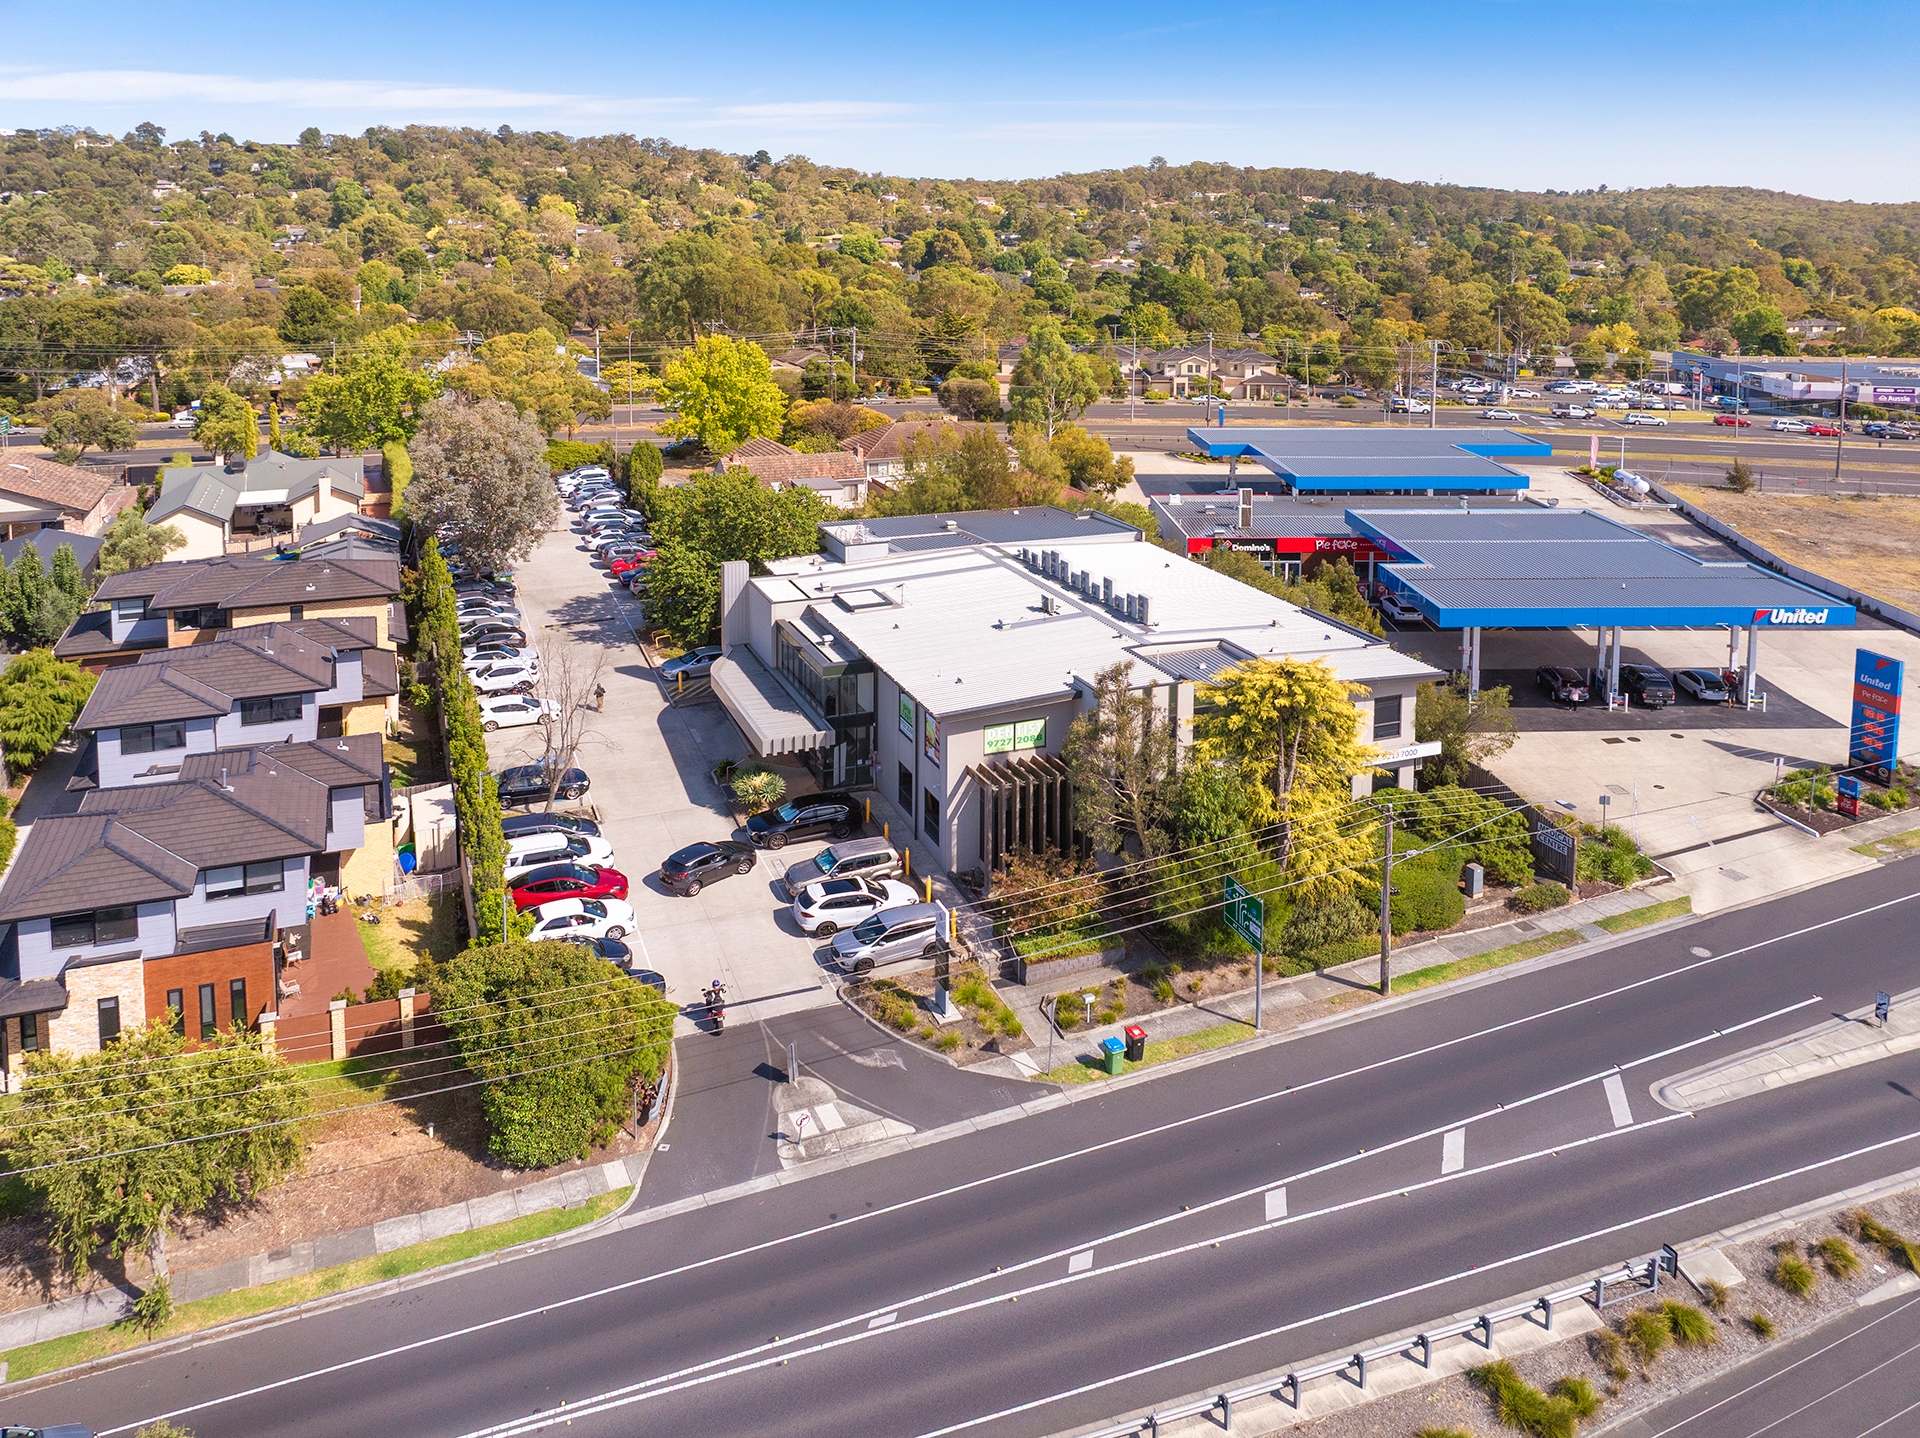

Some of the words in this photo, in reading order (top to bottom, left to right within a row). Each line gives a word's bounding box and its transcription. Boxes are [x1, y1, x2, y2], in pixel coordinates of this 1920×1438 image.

[1887, 395, 1911, 403] Aussie
[1231, 542, 1271, 552] Domino's
[1331, 539, 1358, 551] face
[1770, 608, 1829, 624] United
[1860, 674, 1891, 690] United
[987, 723, 1043, 740] DENTIST
[987, 738, 1013, 748] 9727
[1401, 749, 1418, 757] 7000
[1839, 787, 1856, 796] United
[1539, 824, 1571, 846] MEDICAL
[1538, 834, 1566, 854] CENTRE
